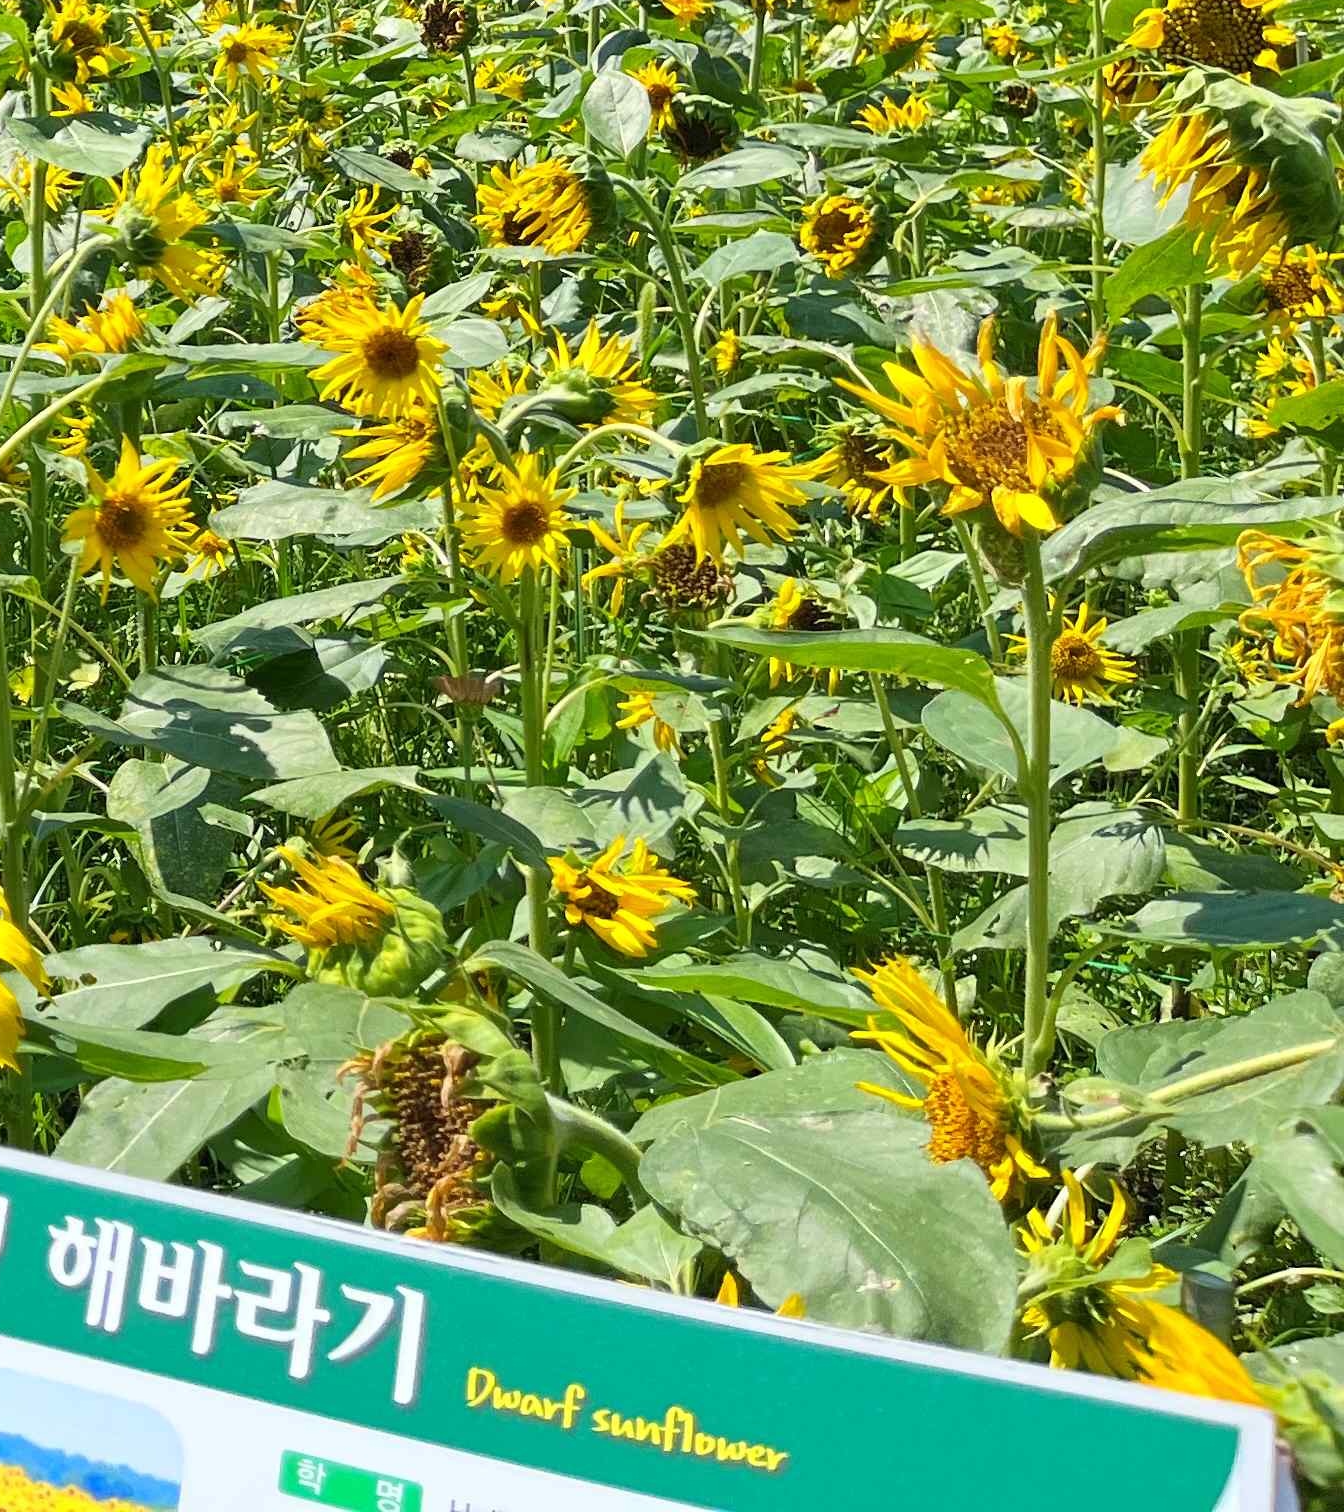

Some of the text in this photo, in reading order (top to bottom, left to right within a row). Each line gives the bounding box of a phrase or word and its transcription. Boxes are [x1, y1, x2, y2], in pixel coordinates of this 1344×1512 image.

[49, 1217, 424, 1405] 해바라기
[466, 1366, 789, 1473] Dwarf sunflower
